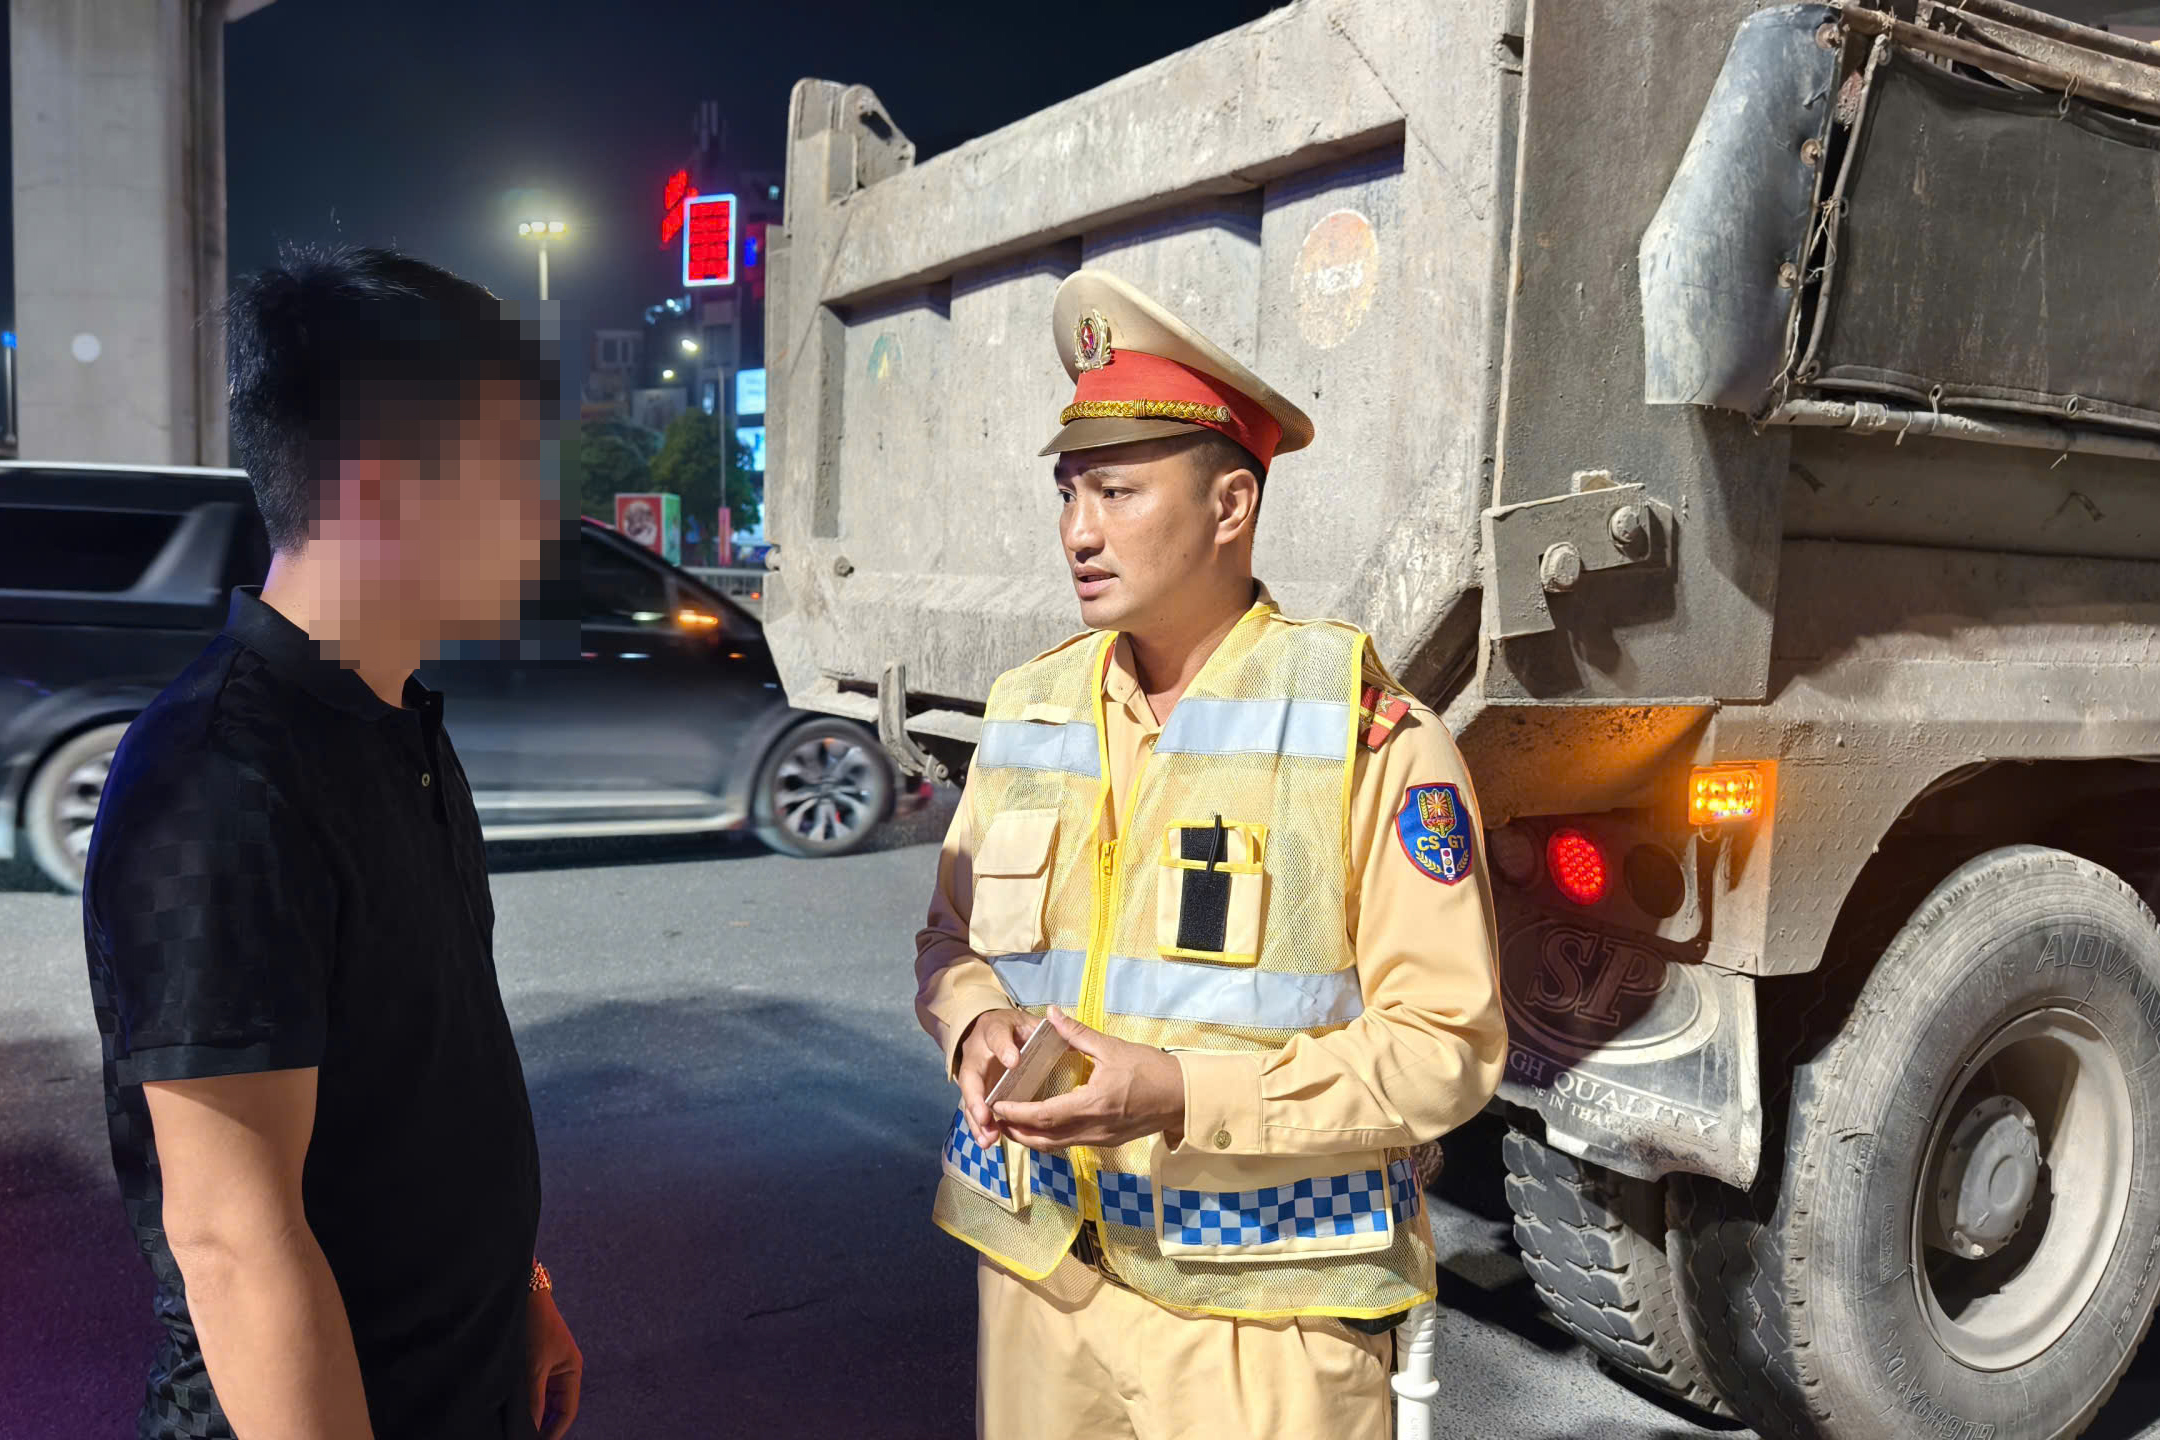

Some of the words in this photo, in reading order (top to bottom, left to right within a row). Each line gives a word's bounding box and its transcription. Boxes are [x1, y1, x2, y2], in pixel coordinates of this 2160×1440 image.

[1417, 835, 1440, 851] CS
[1447, 834, 1465, 849] GT
[1523, 928, 1669, 1026] SP
[1508, 1048, 1546, 1082] GH
[1554, 1071, 1720, 1137] QUALITY
